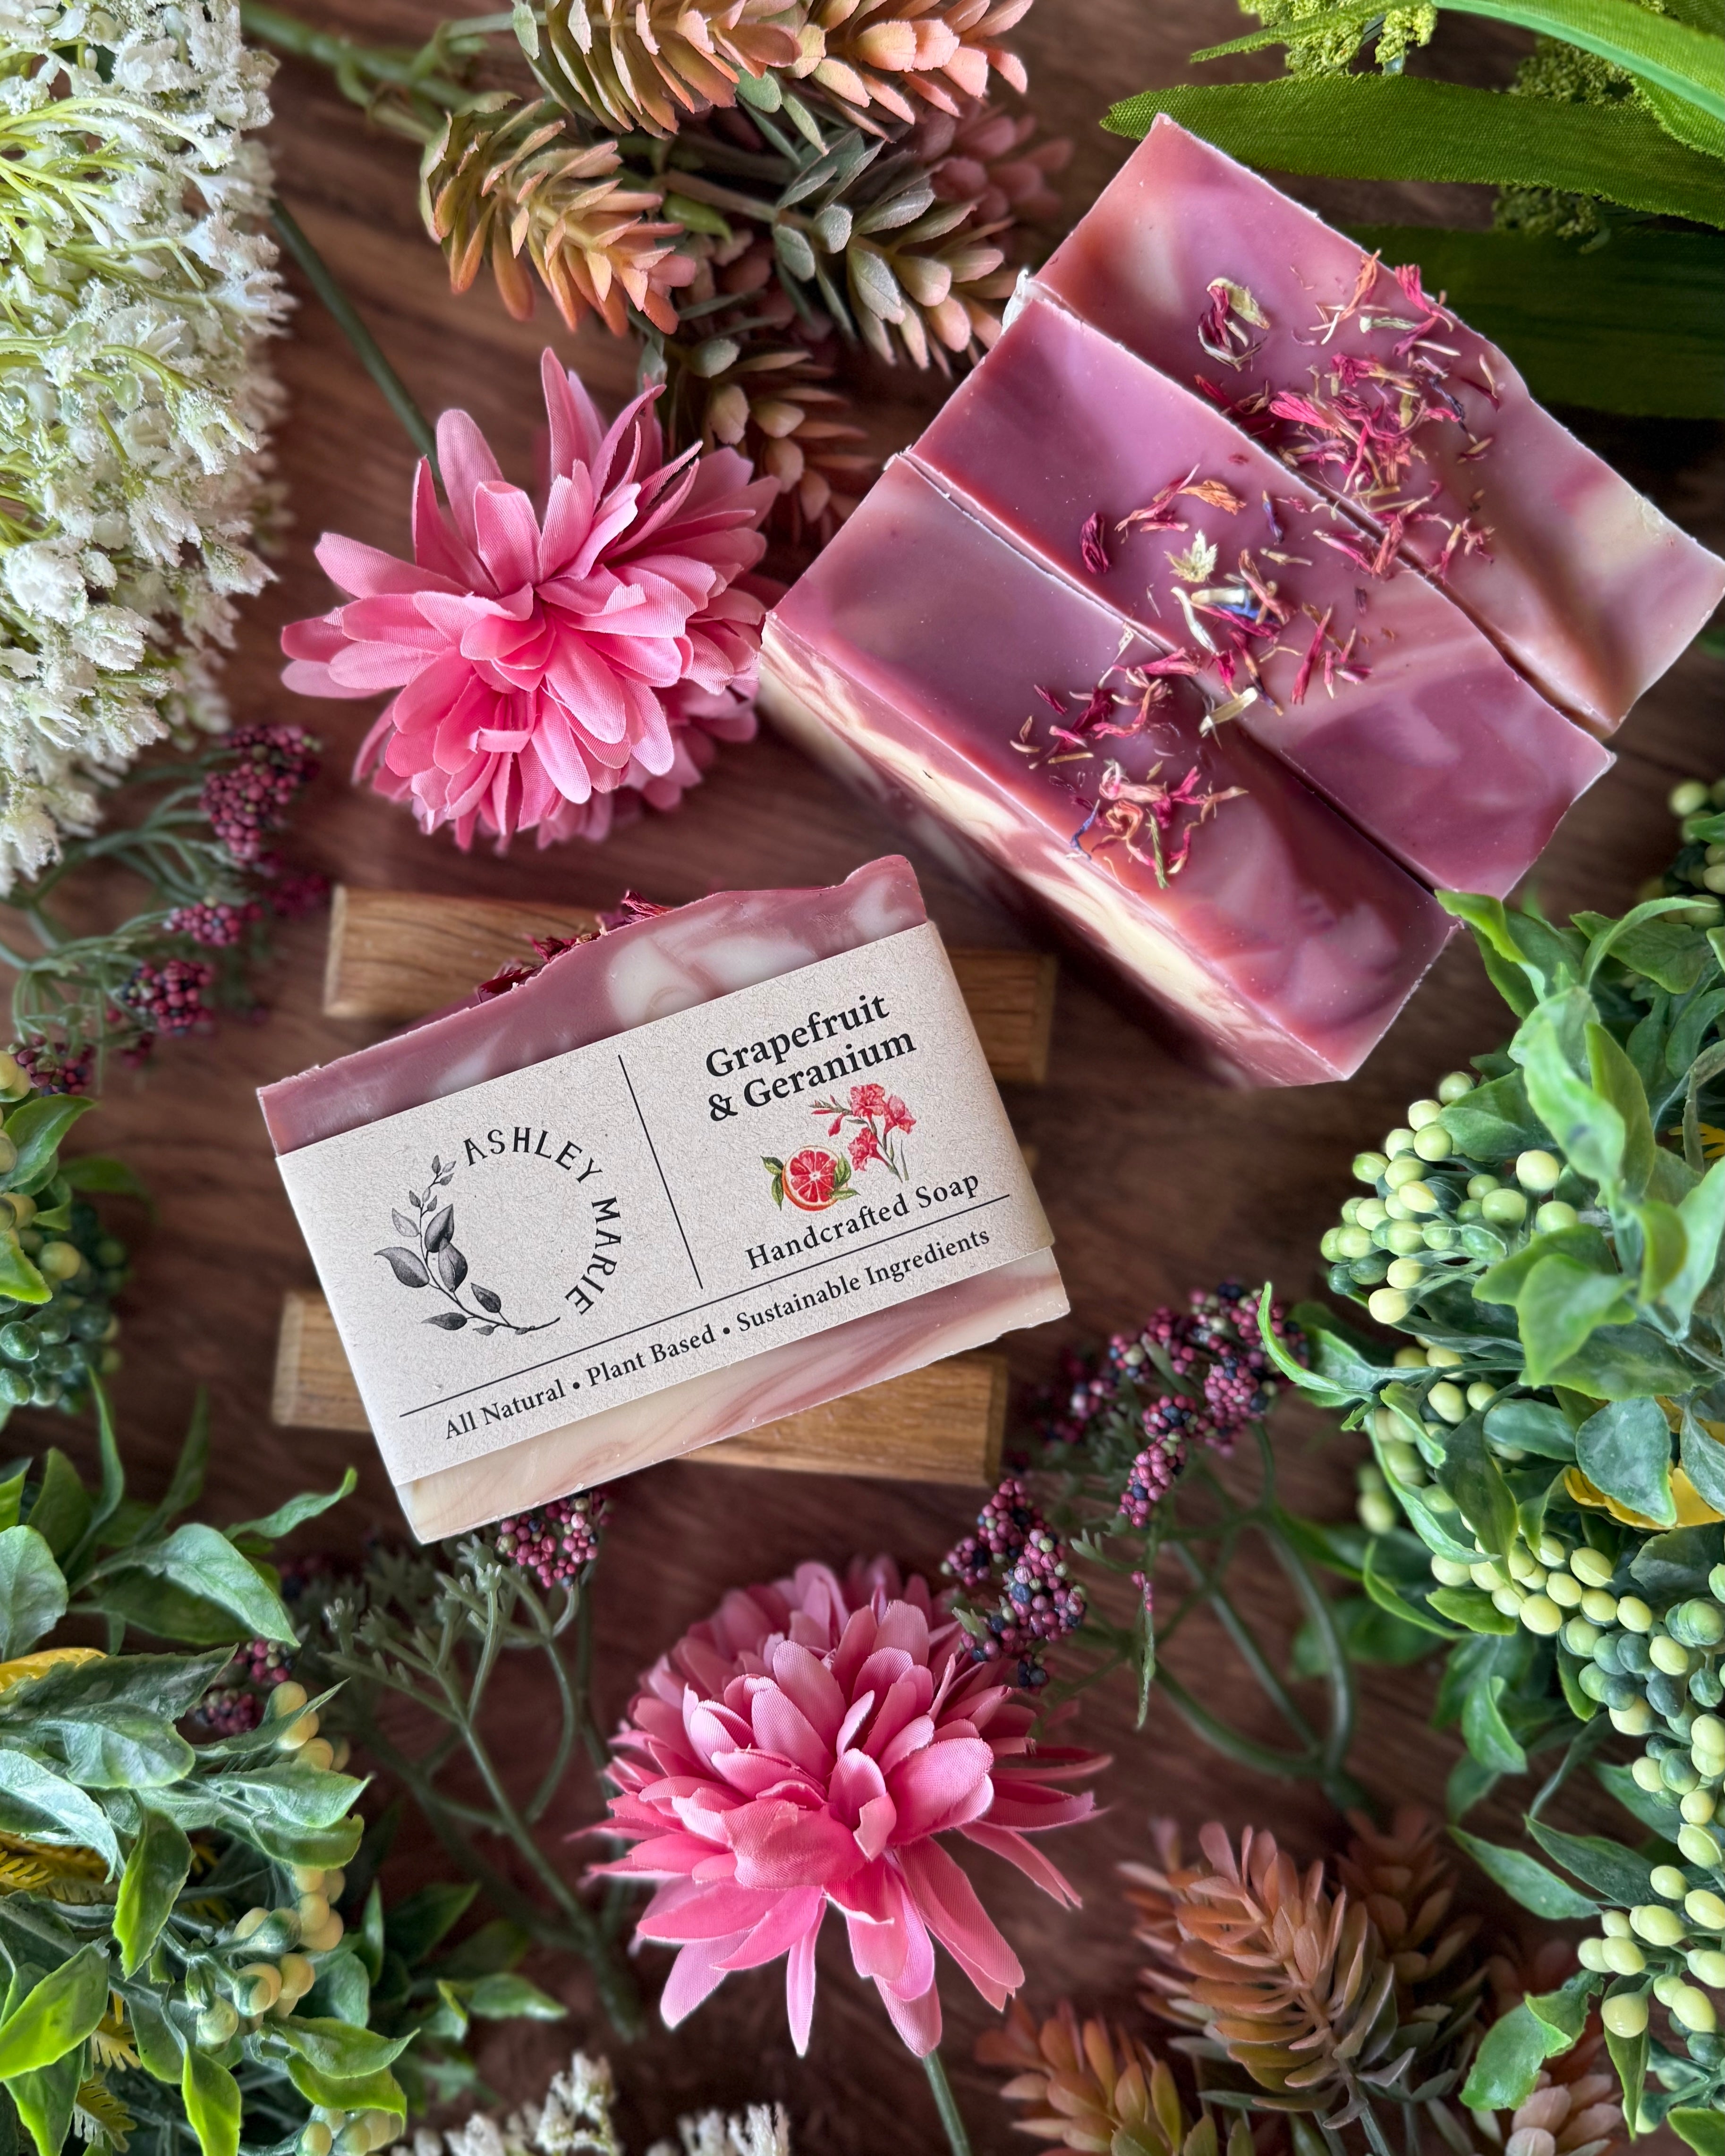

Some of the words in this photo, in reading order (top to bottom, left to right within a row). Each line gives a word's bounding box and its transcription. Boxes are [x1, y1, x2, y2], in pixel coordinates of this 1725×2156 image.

[706, 995, 890, 1077] Grapefruit
[708, 1094, 738, 1122] &
[744, 1033, 917, 1107] Geranium
[463, 1126, 603, 1184] ASHLEY
[565, 1196, 621, 1315] MARIE
[745, 1192, 910, 1270] Handcrafted
[915, 1175, 979, 1209] Soap
[446, 1411, 477, 1439] All
[480, 1379, 566, 1425] Natural
[585, 1353, 646, 1387] Plant
[650, 1323, 716, 1363] Based
[737, 1275, 861, 1331] Sustainable
[864, 1229, 990, 1285] Ingredients
